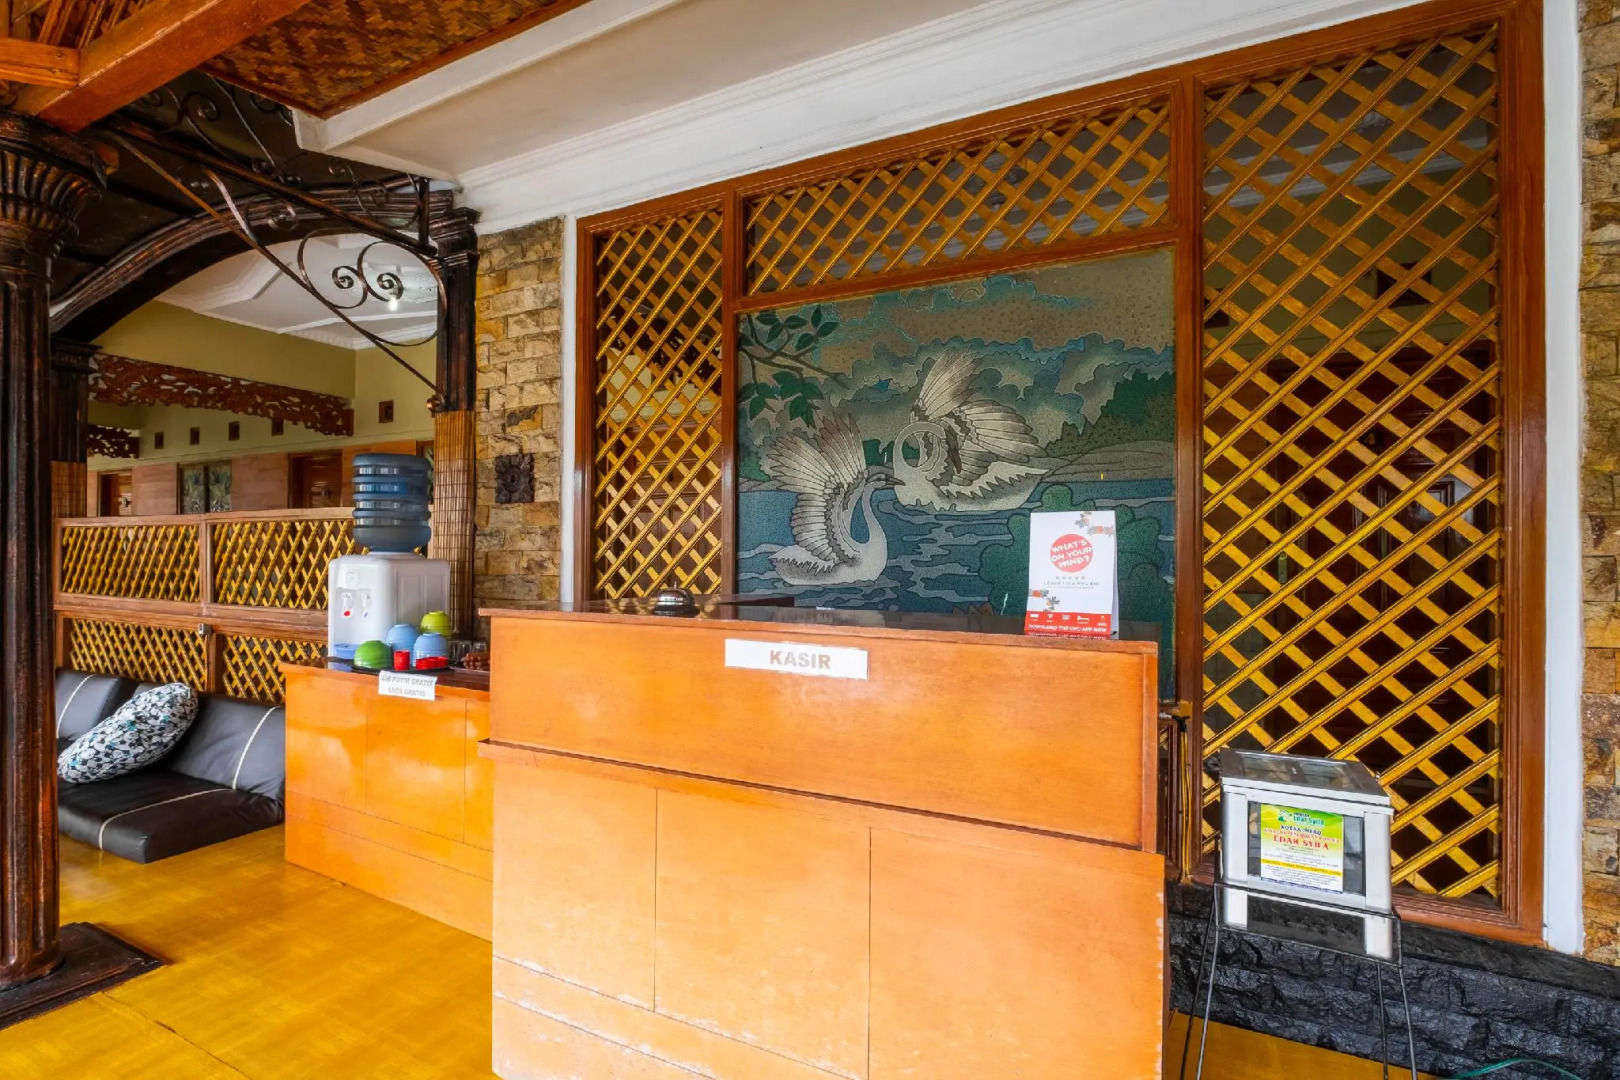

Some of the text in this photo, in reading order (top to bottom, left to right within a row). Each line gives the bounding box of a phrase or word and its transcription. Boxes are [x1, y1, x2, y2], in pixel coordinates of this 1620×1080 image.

[1051, 539, 1088, 553] WHAT'S
[1051, 546, 1092, 562] ON YOUR
[1059, 555, 1090, 568] MIND?
[1028, 623, 1058, 631] DOWNLOAD
[769, 650, 831, 670] KASIR
[410, 678, 435, 687] GRATIS
